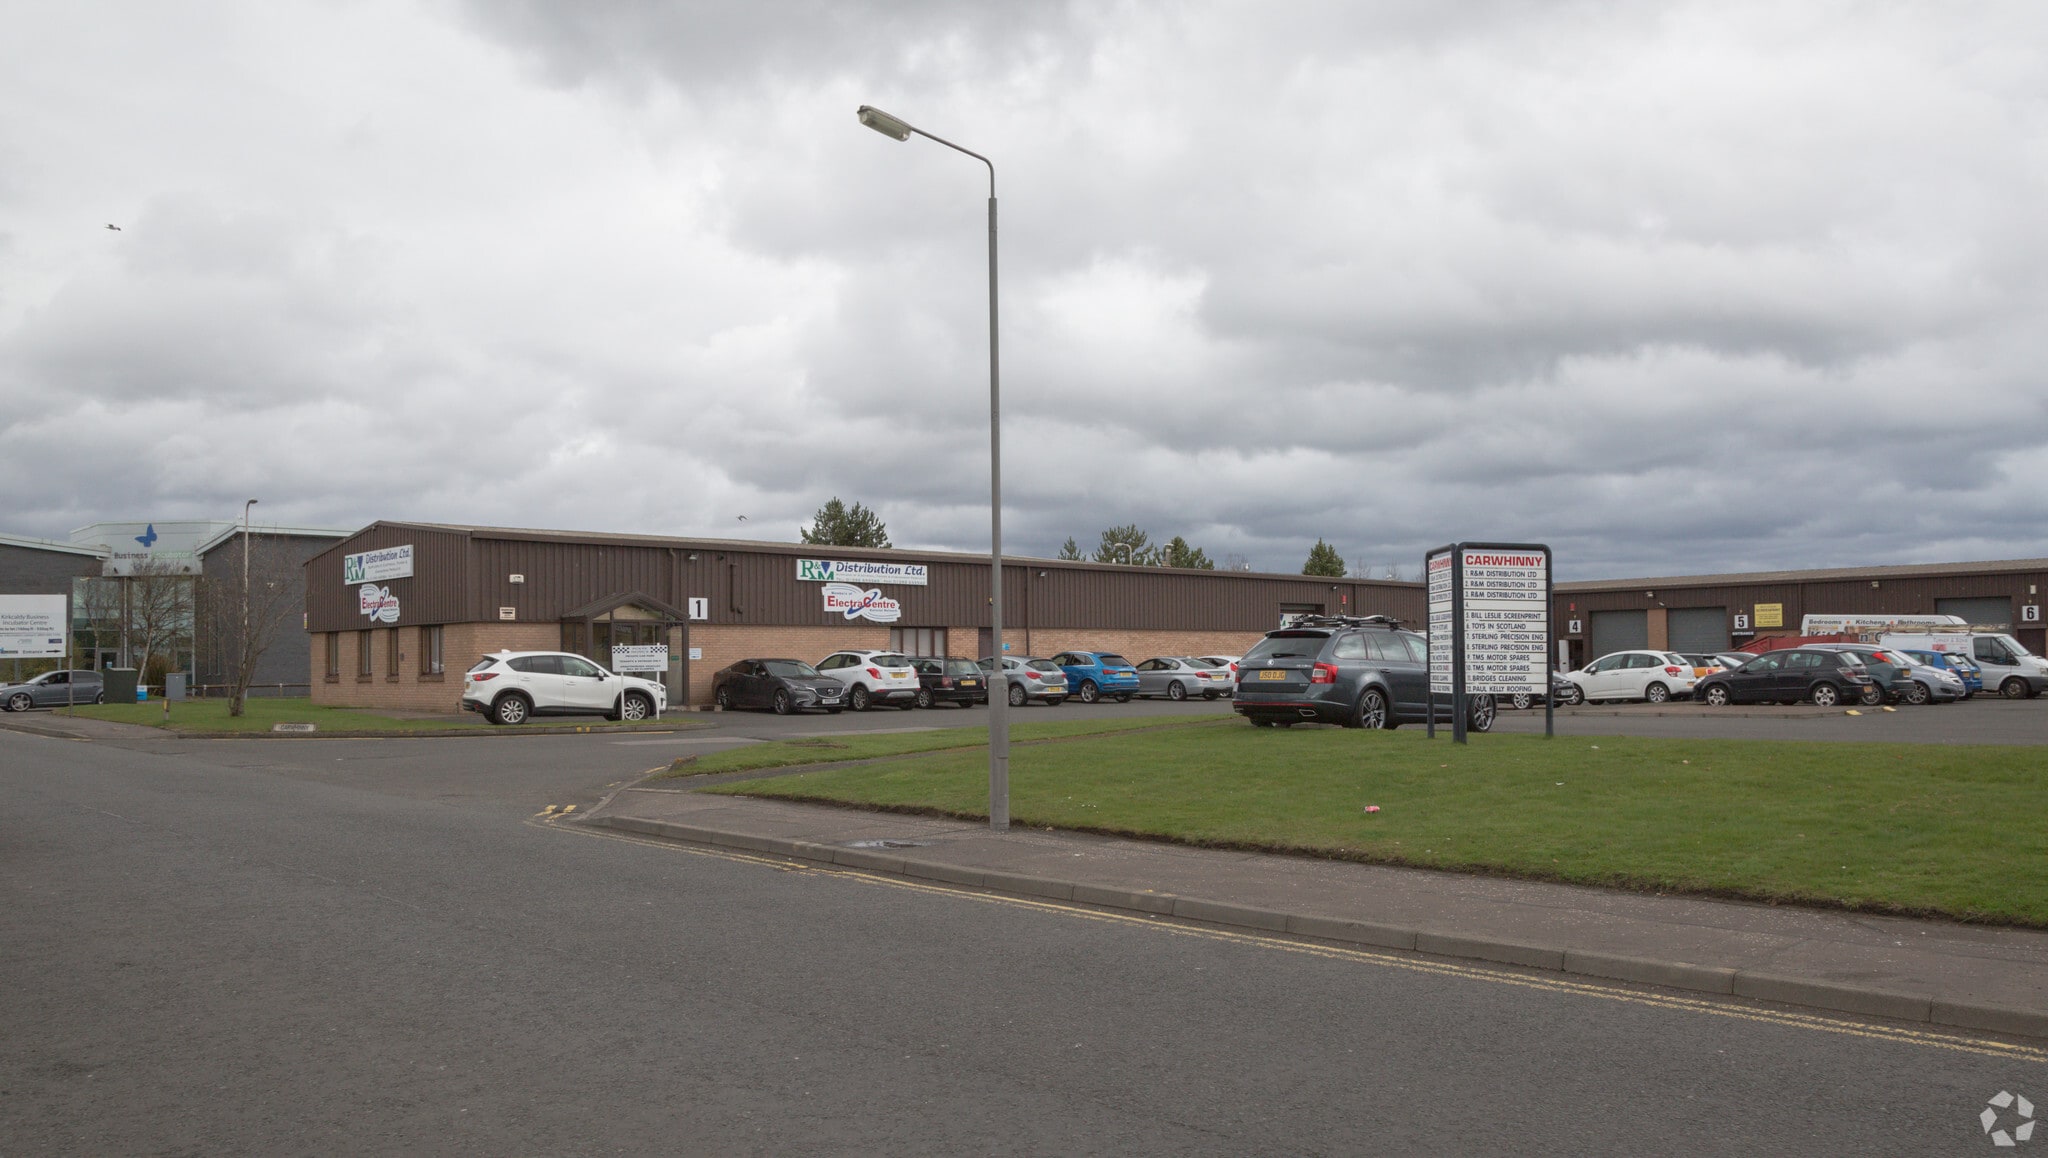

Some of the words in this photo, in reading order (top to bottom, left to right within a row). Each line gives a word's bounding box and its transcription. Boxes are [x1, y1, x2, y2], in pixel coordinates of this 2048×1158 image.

[114, 552, 148, 560] Business
[366, 551, 397, 564] Distribution
[1465, 555, 1542, 566] CARWHINNY
[836, 562, 900, 575] Distribution
[904, 565, 925, 576] Ltd.
[696, 600, 701, 617] 1
[827, 596, 895, 609] ElectraCentre
[2026, 607, 2034, 620] 6
[1572, 622, 1578, 631] 4
[1738, 616, 1744, 627] 5
